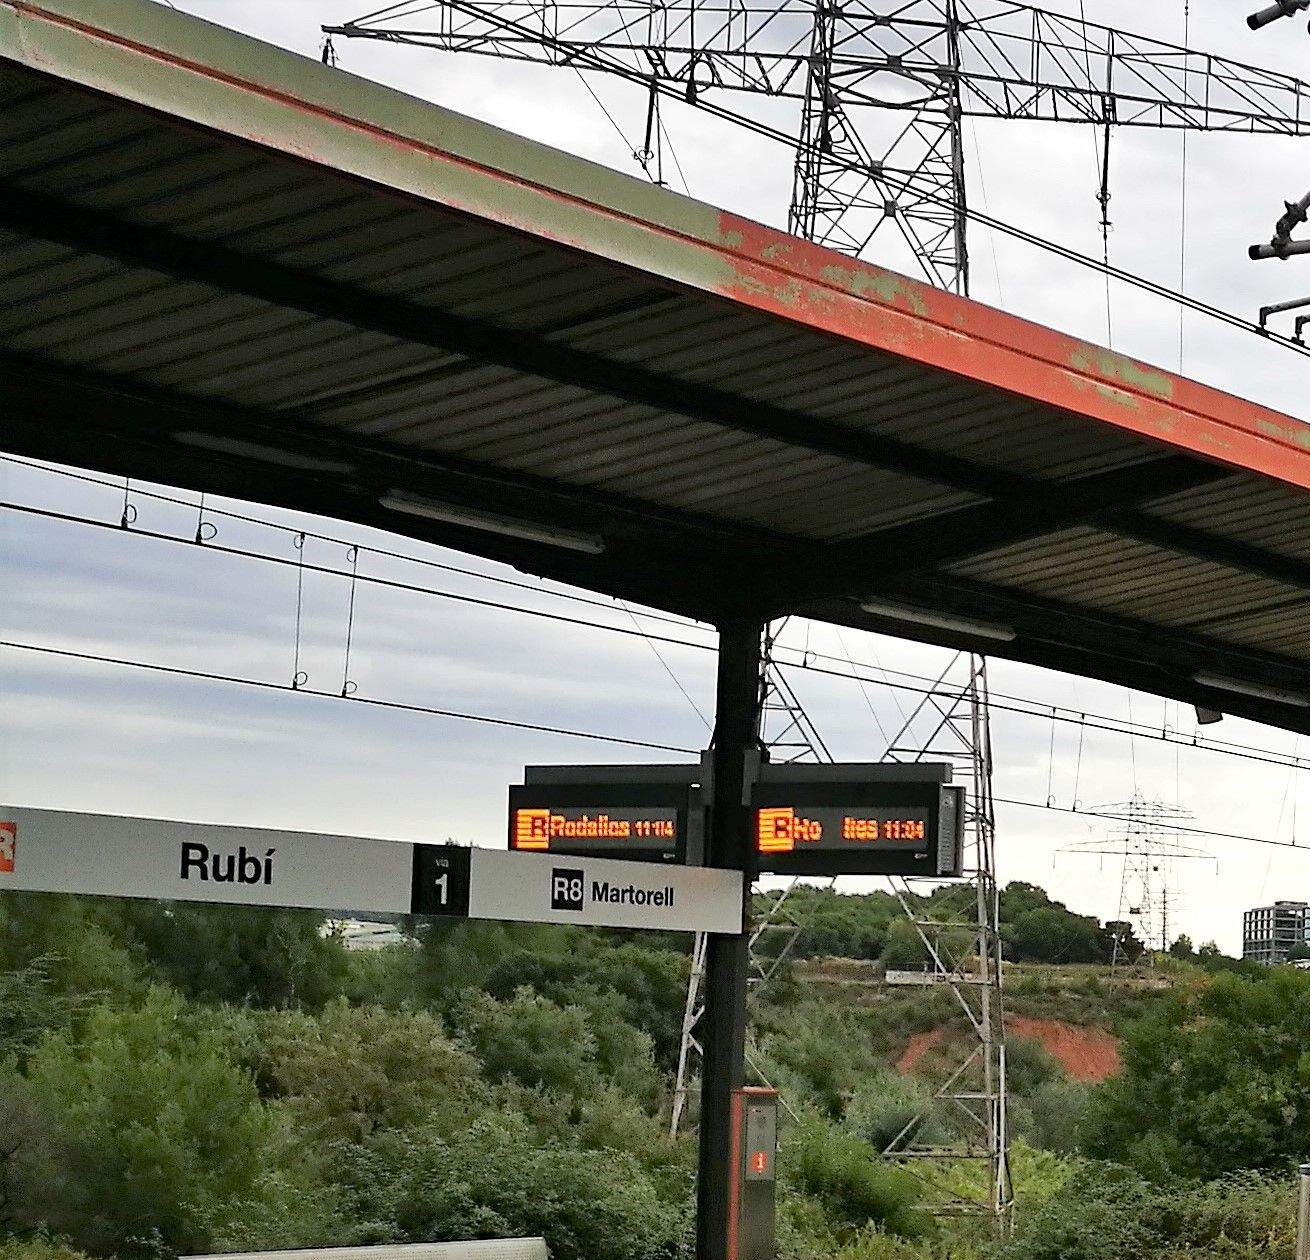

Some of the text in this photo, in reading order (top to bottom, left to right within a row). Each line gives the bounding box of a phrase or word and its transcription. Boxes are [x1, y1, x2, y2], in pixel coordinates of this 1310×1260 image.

[180, 841, 276, 885] Rubí
[434, 873, 448, 905] 1
[553, 876, 675, 907] R8 Martorell
